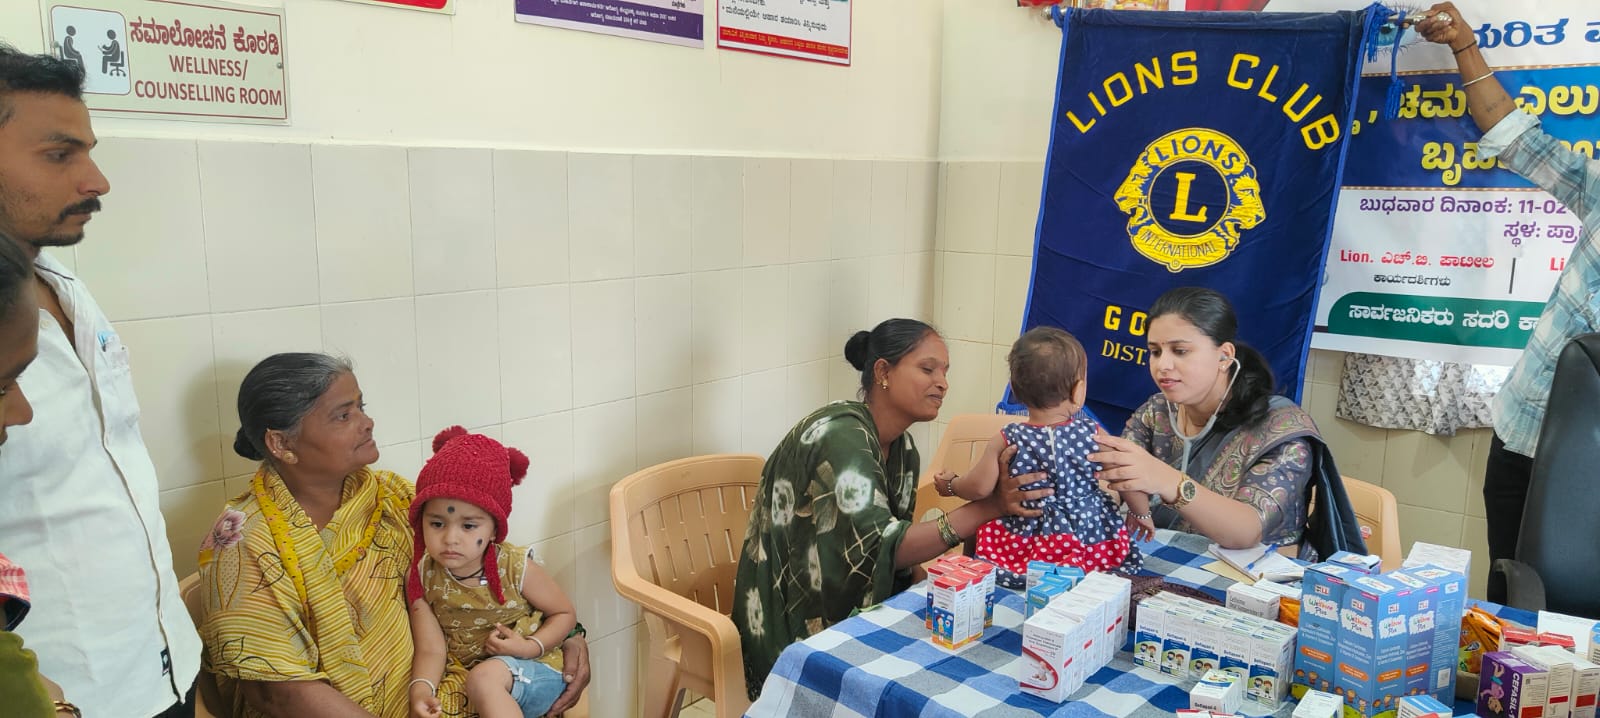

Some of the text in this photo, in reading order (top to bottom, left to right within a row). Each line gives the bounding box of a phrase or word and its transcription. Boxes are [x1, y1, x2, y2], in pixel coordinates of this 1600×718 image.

[129, 15, 280, 56] ಸಮಾಲೋಚನೆ ಕೊಠಡಿ
[169, 54, 248, 81] WELLNESS/
[134, 80, 282, 106] COUNSELLING ROOM
[1066, 49, 1340, 151] LIONS CLUB
[1154, 134, 1241, 170] LIONS
[1168, 171, 1208, 223] L
[1359, 195, 1567, 216] ಬುಧವಾರ ದಿನಾಂಕ: 11-02
[1138, 229, 1219, 258] INTERNATIONAL
[1503, 220, 1583, 248] ಸ್ಥಳ: ಪ್ರಾ
[1340, 249, 1374, 263] Lion.
[1439, 254, 1495, 269] ಪಾಟೀಲ
[1550, 257, 1565, 271] Li
[1373, 272, 1451, 286] ಕಾರ್ಯದರ್ಶಿಗಳು
[1103, 304, 1148, 337] GO
[1348, 304, 1540, 331] ಸಾರ್ವಜನಿಕರು ಸದರಿ ಕಾ
[1101, 339, 1148, 366] DIST.
